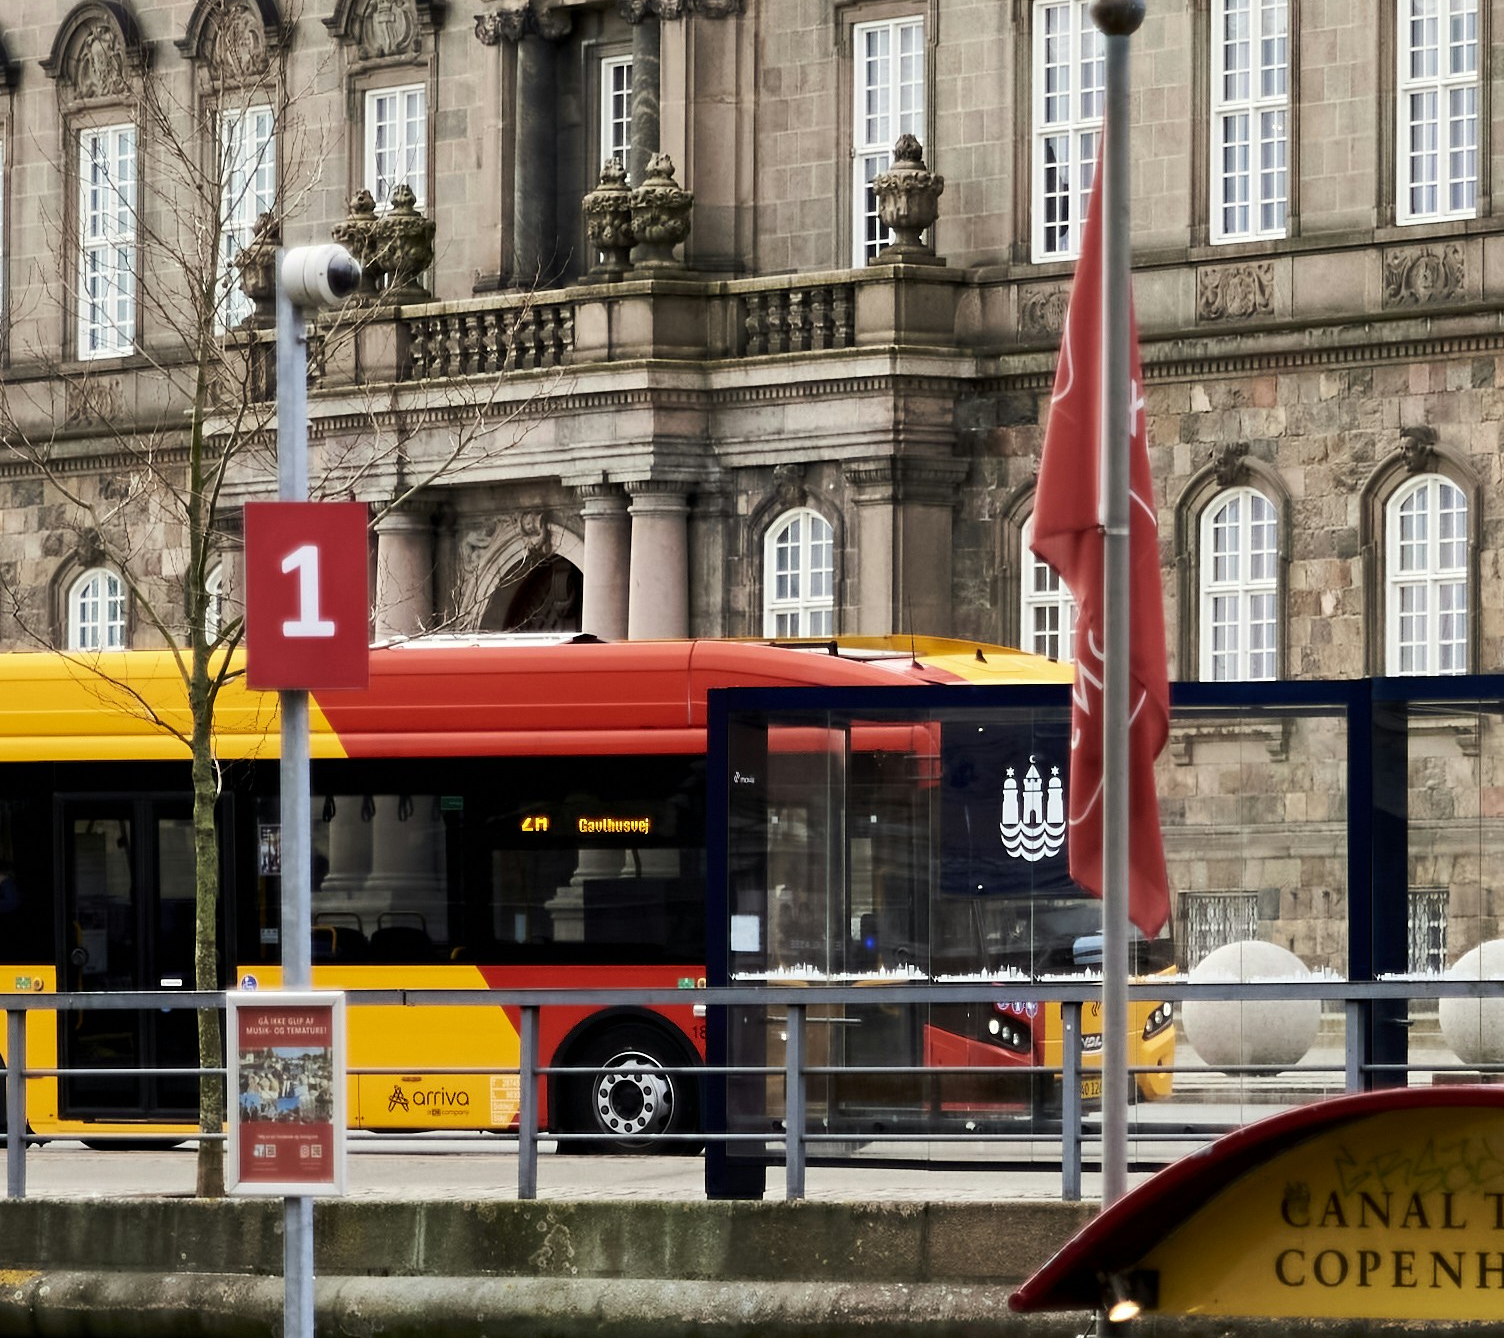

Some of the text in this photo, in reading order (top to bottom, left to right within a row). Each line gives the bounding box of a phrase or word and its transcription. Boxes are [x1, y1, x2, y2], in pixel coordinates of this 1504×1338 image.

[280, 545, 336, 638] 1
[413, 1087, 470, 1106] arriva
[1280, 1191, 1468, 1230] CANAL
